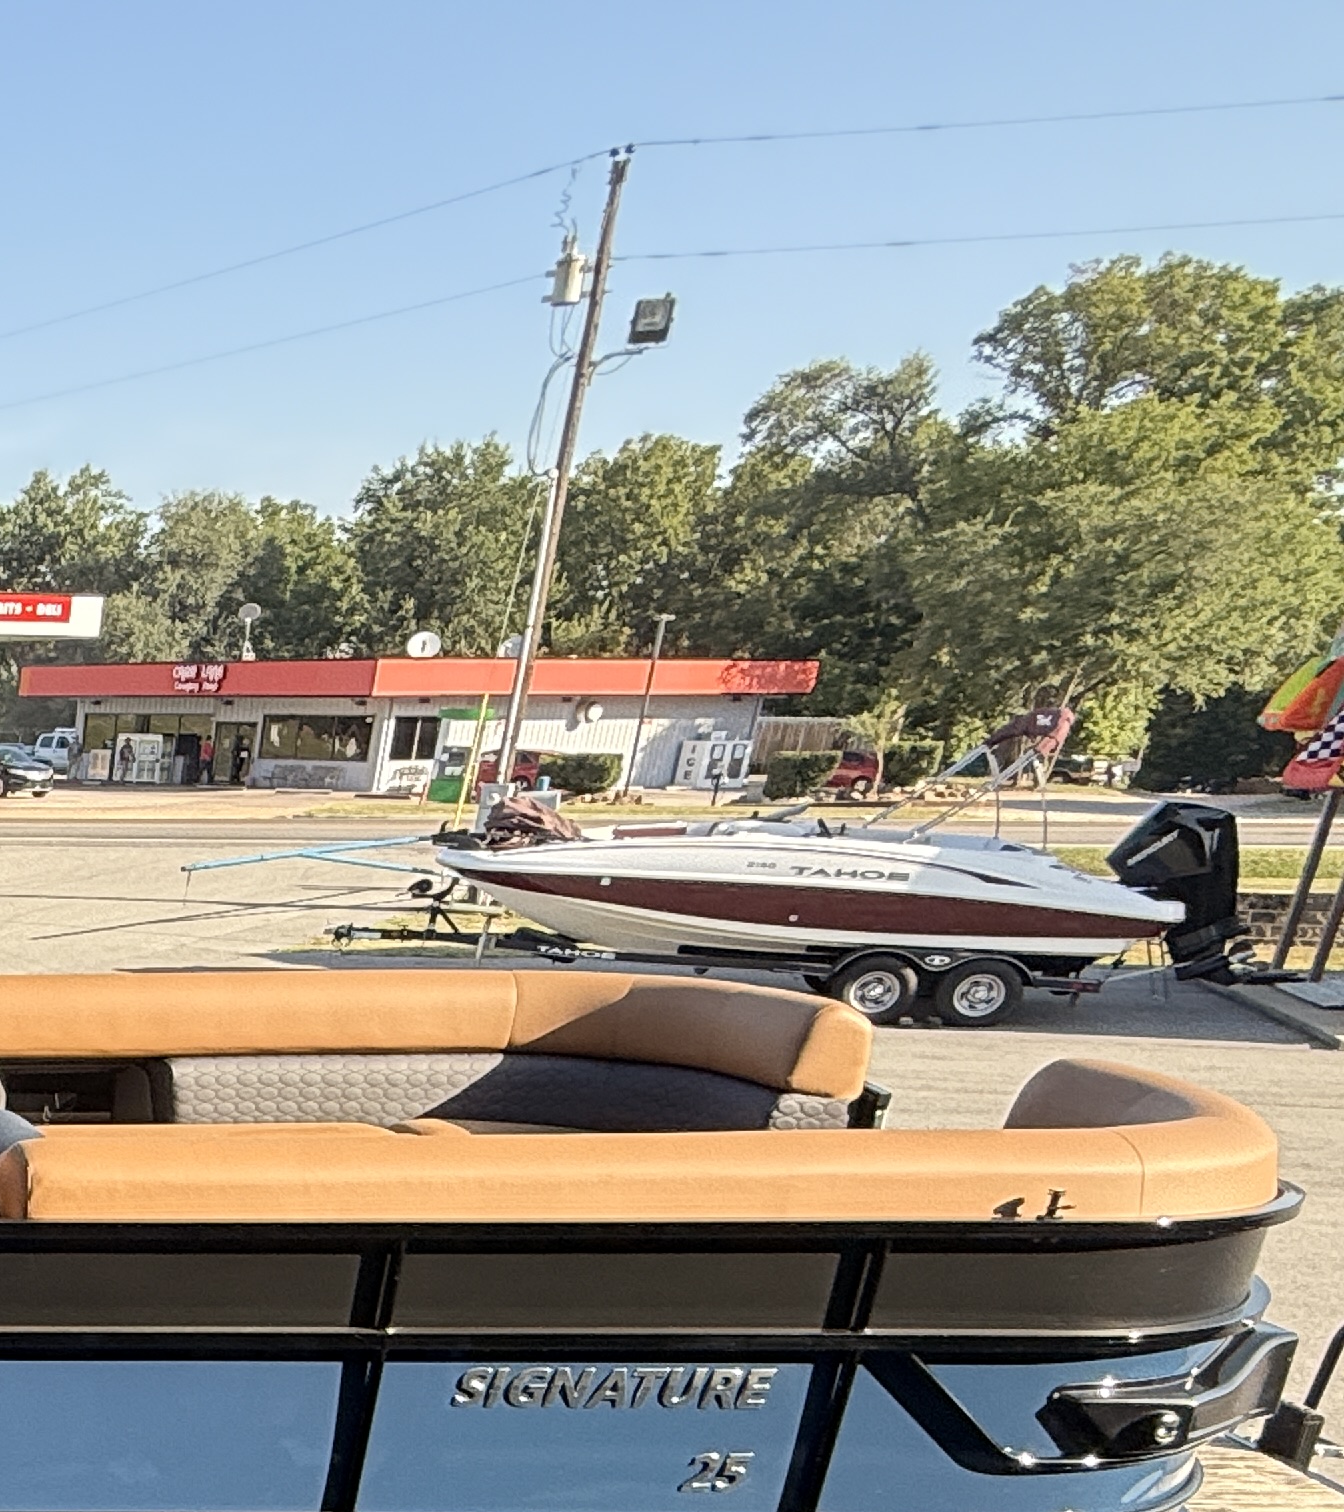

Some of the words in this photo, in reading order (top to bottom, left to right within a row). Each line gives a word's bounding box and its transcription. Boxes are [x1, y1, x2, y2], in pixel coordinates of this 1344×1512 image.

[35, 602, 63, 617] DELI
[791, 866, 910, 882] TAHOE
[537, 945, 616, 959] TAHOE
[450, 1365, 779, 1409] SIGNATURE
[676, 1450, 756, 1493] 25
